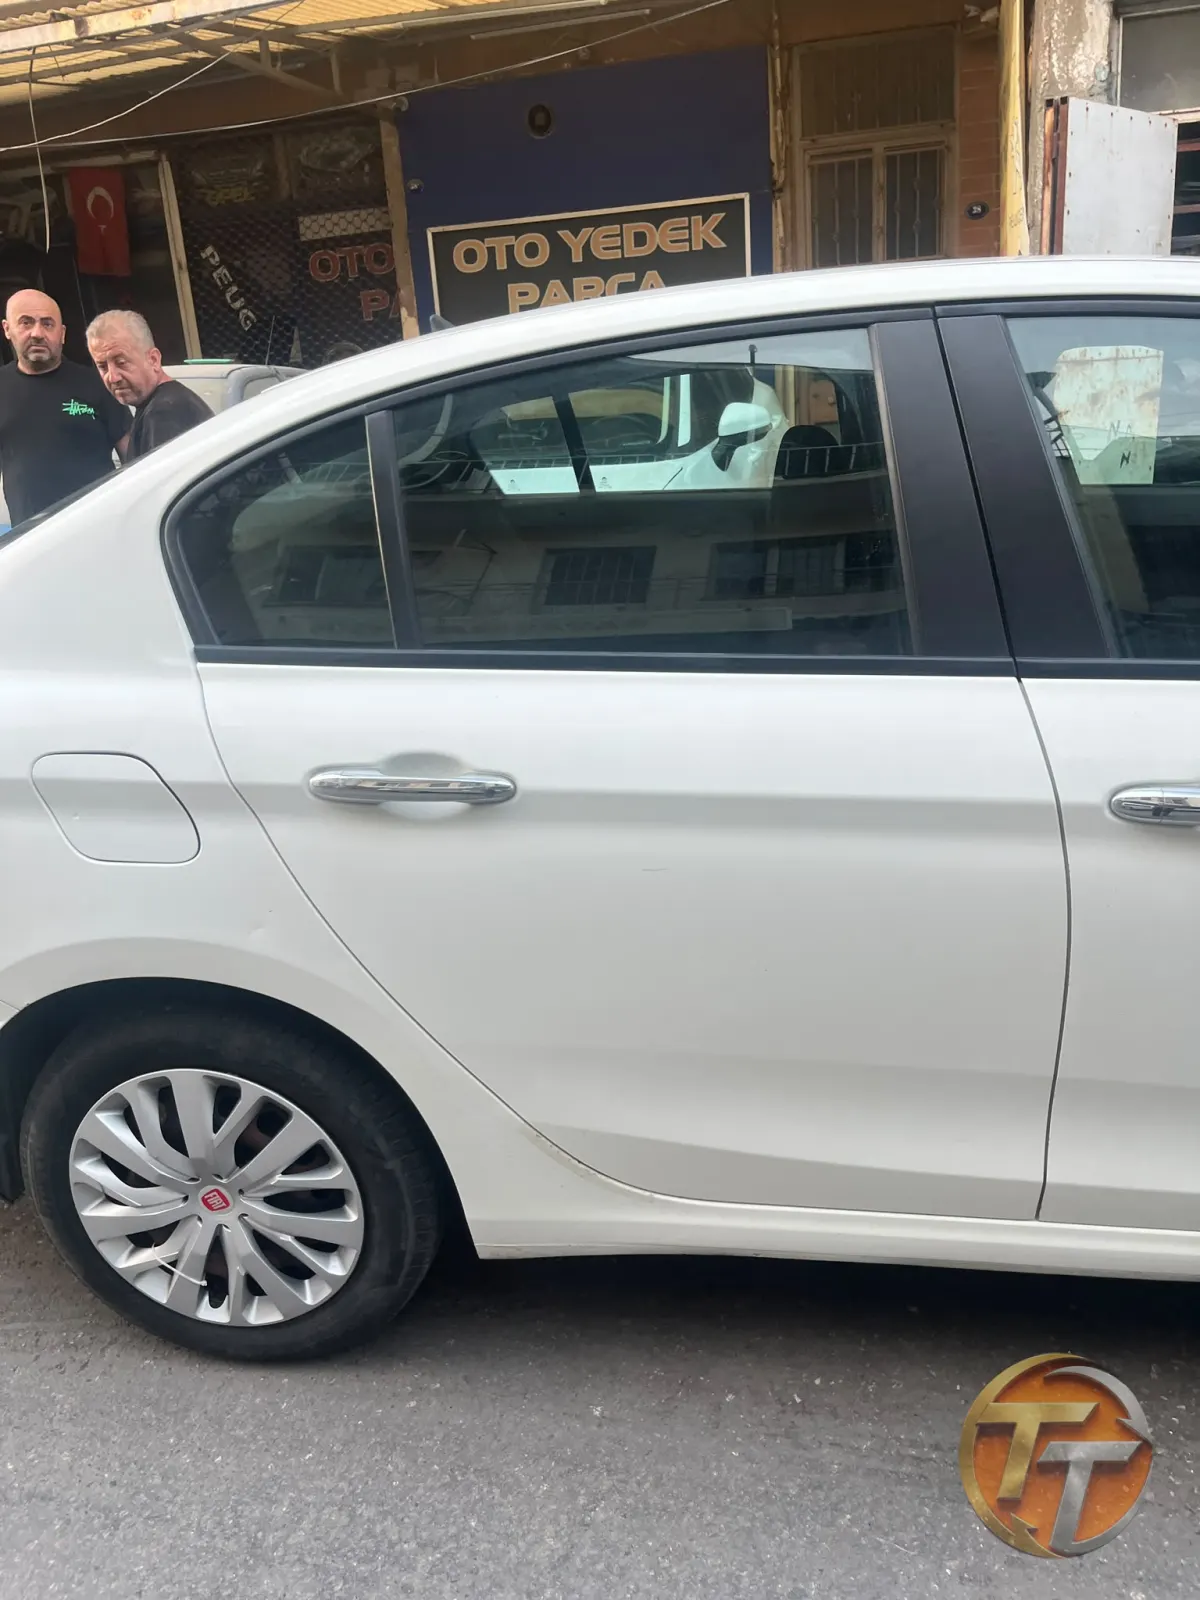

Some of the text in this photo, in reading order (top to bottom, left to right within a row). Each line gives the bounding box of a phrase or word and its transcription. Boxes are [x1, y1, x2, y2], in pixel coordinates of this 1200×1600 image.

[452, 212, 727, 273] OTO YEDEK
[309, 244, 395, 282] OTO
[204, 1191, 227, 1210] FIAT
